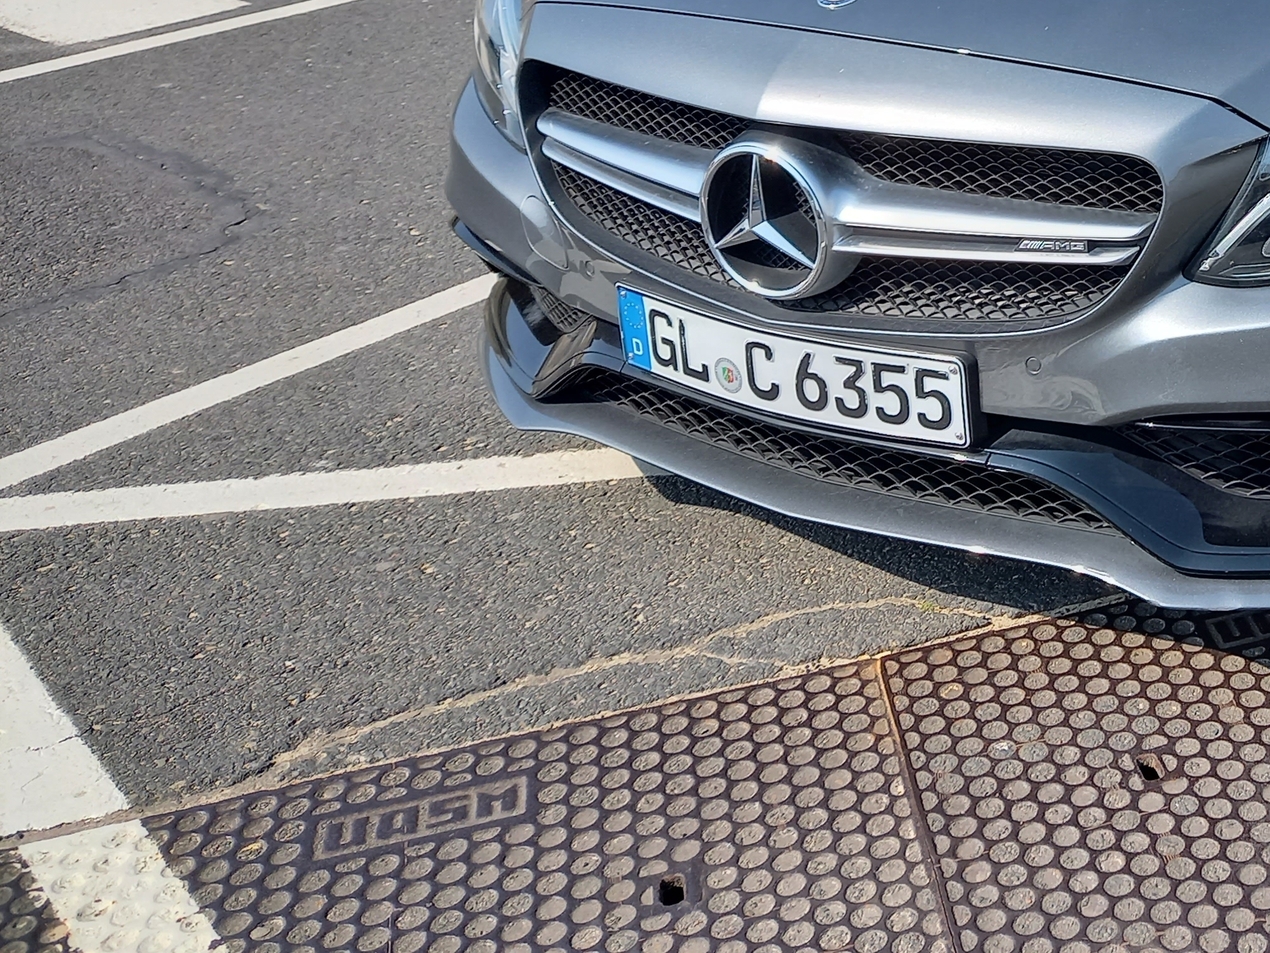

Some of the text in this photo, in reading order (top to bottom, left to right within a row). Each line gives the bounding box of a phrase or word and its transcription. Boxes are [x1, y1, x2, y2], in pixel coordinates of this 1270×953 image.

[632, 337, 643, 356] D
[648, 308, 709, 383] GL
[744, 340, 780, 401] C
[795, 352, 952, 431] 6355
